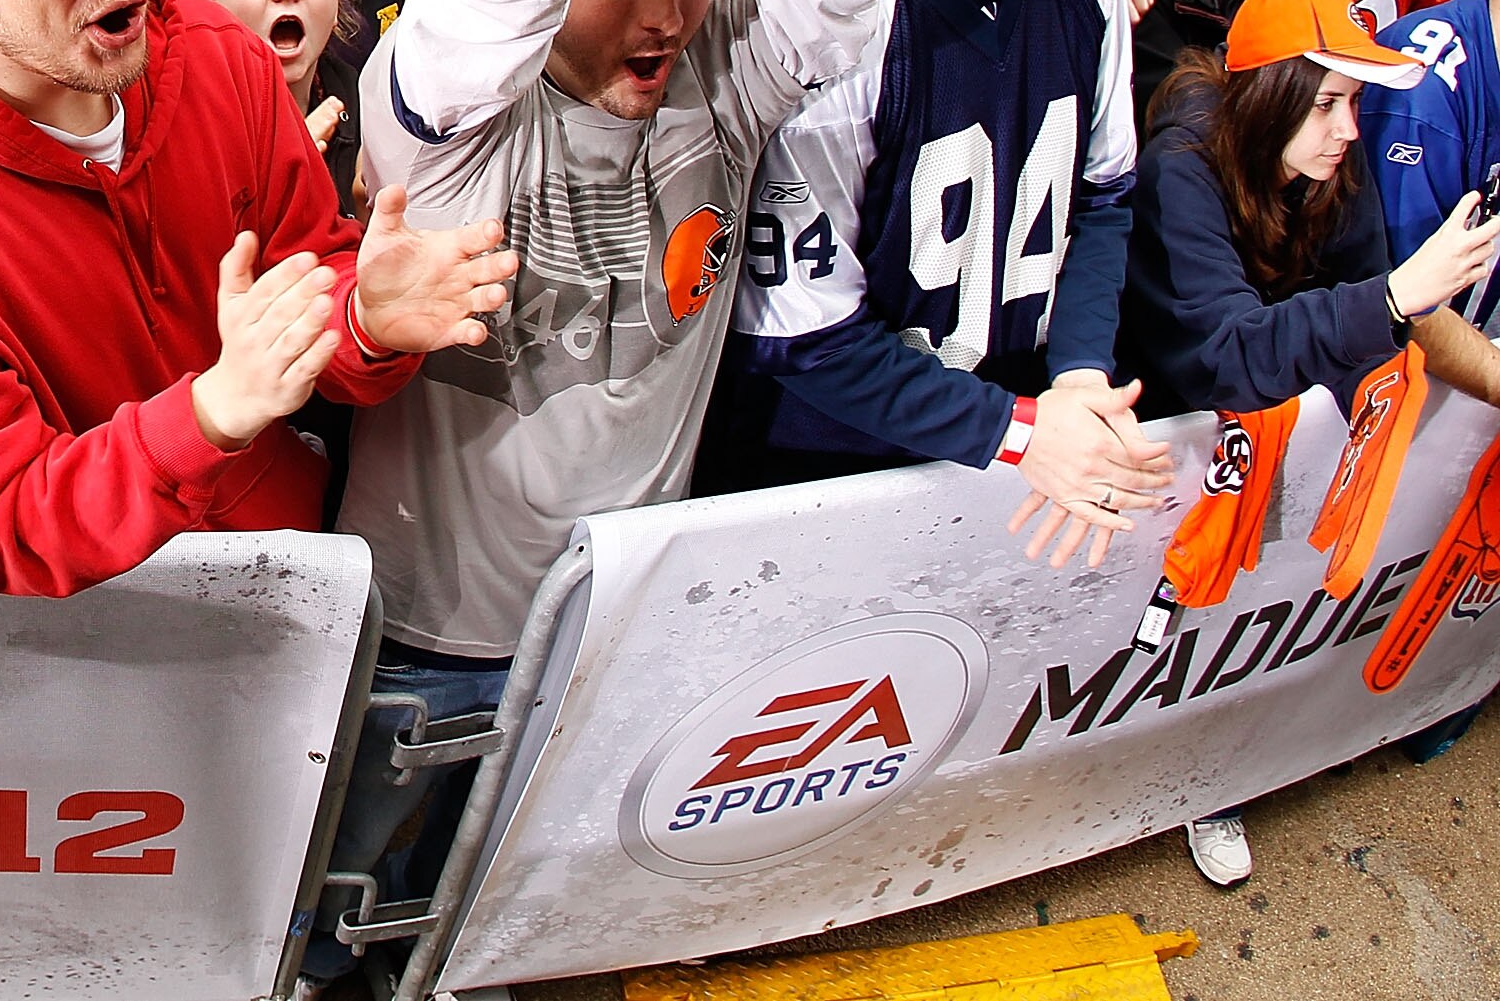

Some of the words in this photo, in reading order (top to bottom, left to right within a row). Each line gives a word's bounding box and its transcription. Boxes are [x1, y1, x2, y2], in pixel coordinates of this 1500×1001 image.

[748, 212, 838, 289] 94
[909, 95, 1077, 372] 94
[688, 674, 913, 791] EA
[668, 751, 907, 833] SPORTS
